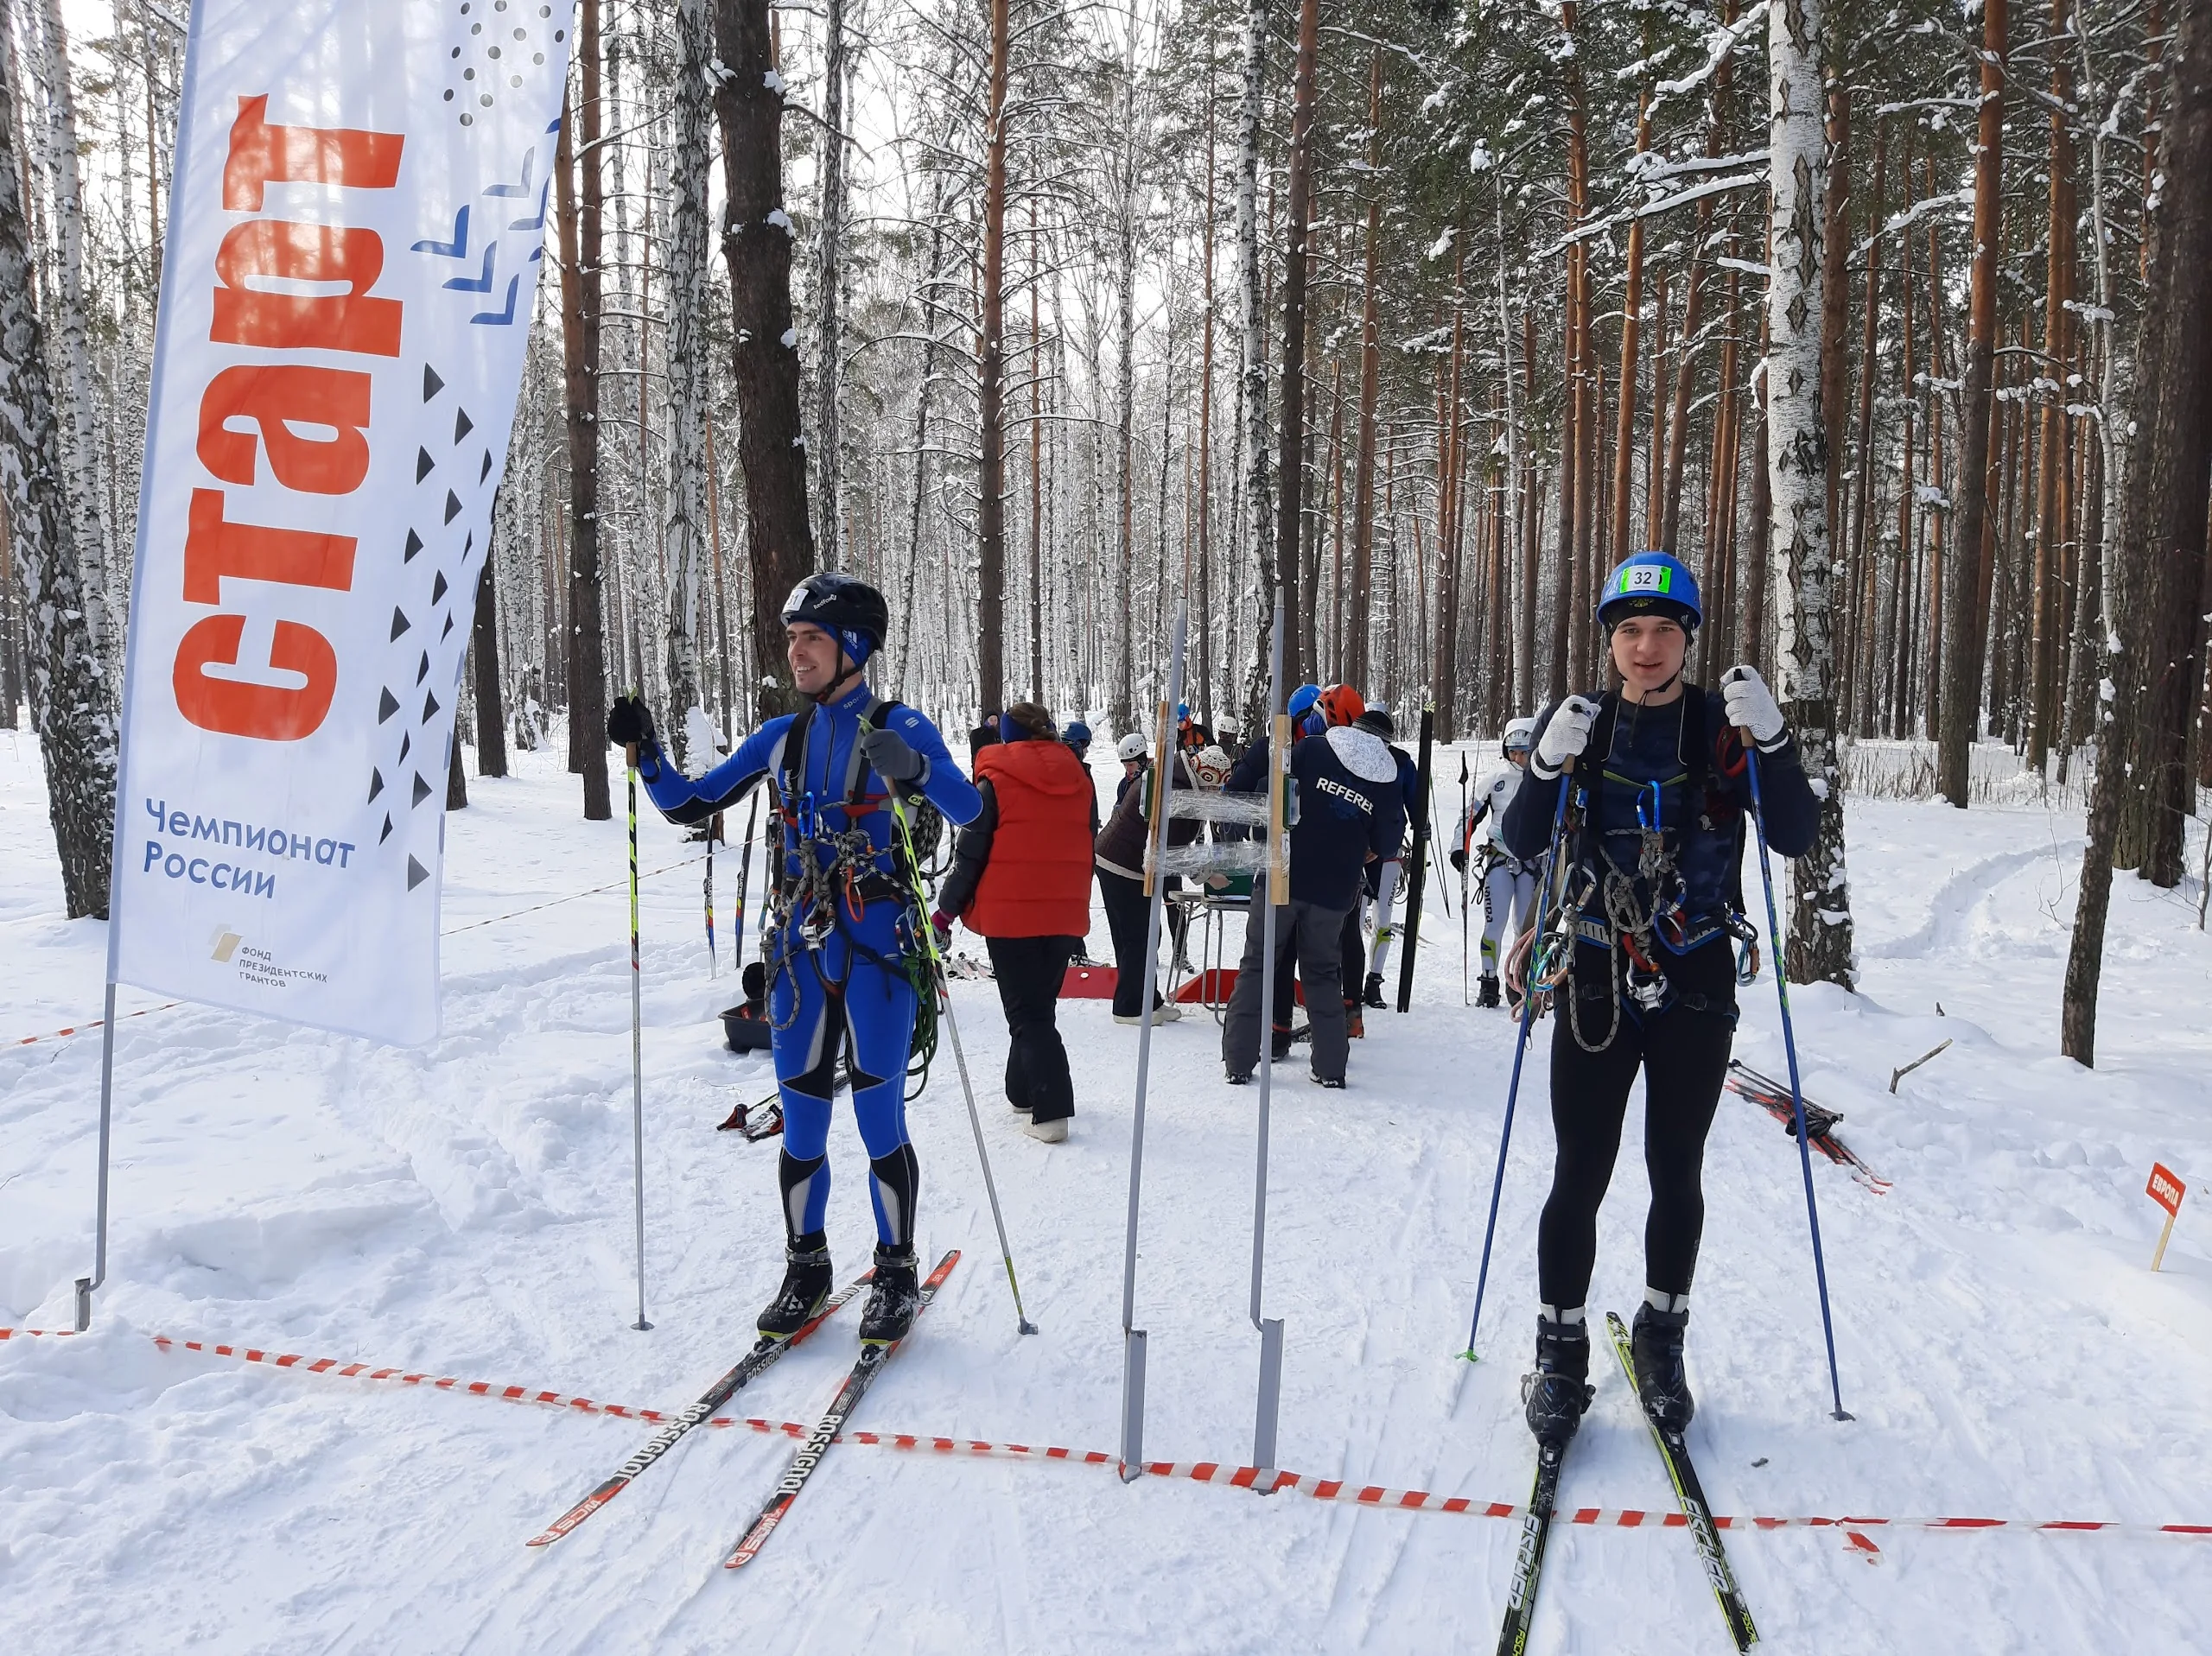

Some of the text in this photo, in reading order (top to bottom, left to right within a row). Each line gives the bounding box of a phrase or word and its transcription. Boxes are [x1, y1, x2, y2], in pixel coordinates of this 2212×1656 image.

[1634, 571, 1652, 585] 32
[145, 797, 356, 869] Чемпионат
[143, 840, 276, 899] России
[238, 959, 328, 983] ПРЕЗИДЕНТСКИХ
[241, 946, 272, 962] ФОНД
[239, 972, 287, 987] ГРАНТОВ
[2152, 1173, 2180, 1209] ЕВРОПА
[747, 1343, 787, 1382] ROSSIGNOL
[607, 1401, 712, 1482] ROSSIGNOL
[771, 1414, 844, 1499] ROSSIGNOL
